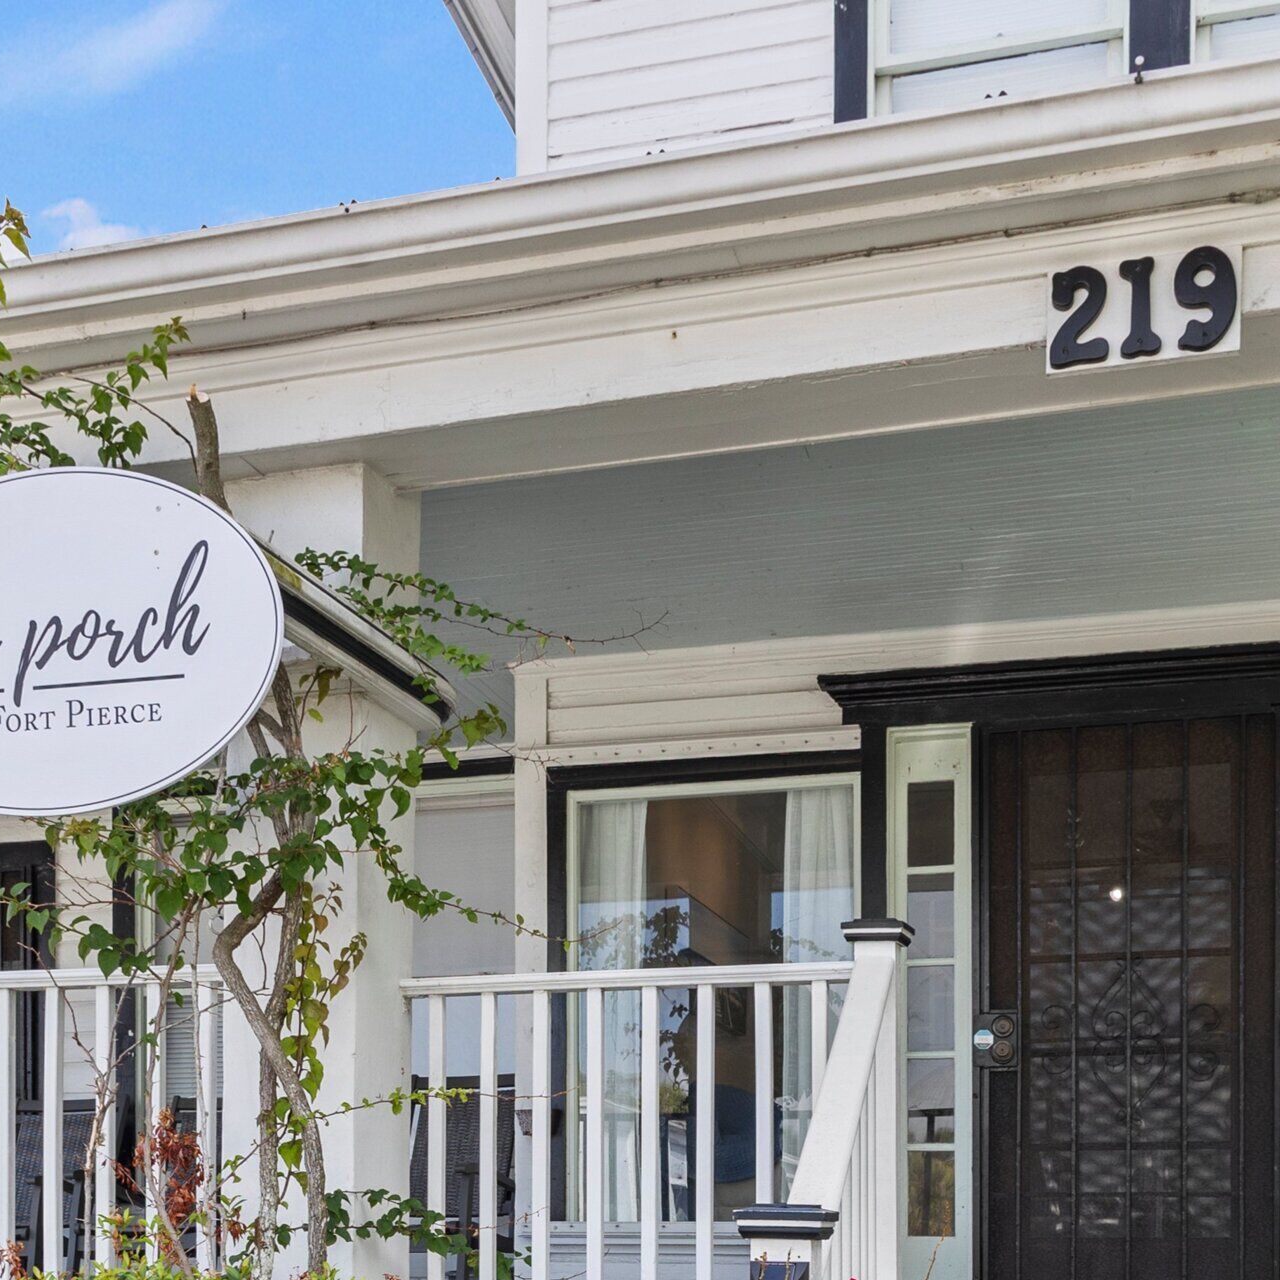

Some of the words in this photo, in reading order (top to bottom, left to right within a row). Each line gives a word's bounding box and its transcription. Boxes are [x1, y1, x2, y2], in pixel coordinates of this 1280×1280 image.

[1050, 246, 1237, 369] 219
[13, 540, 210, 707] porch
[66, 699, 162, 729] PIERCE
